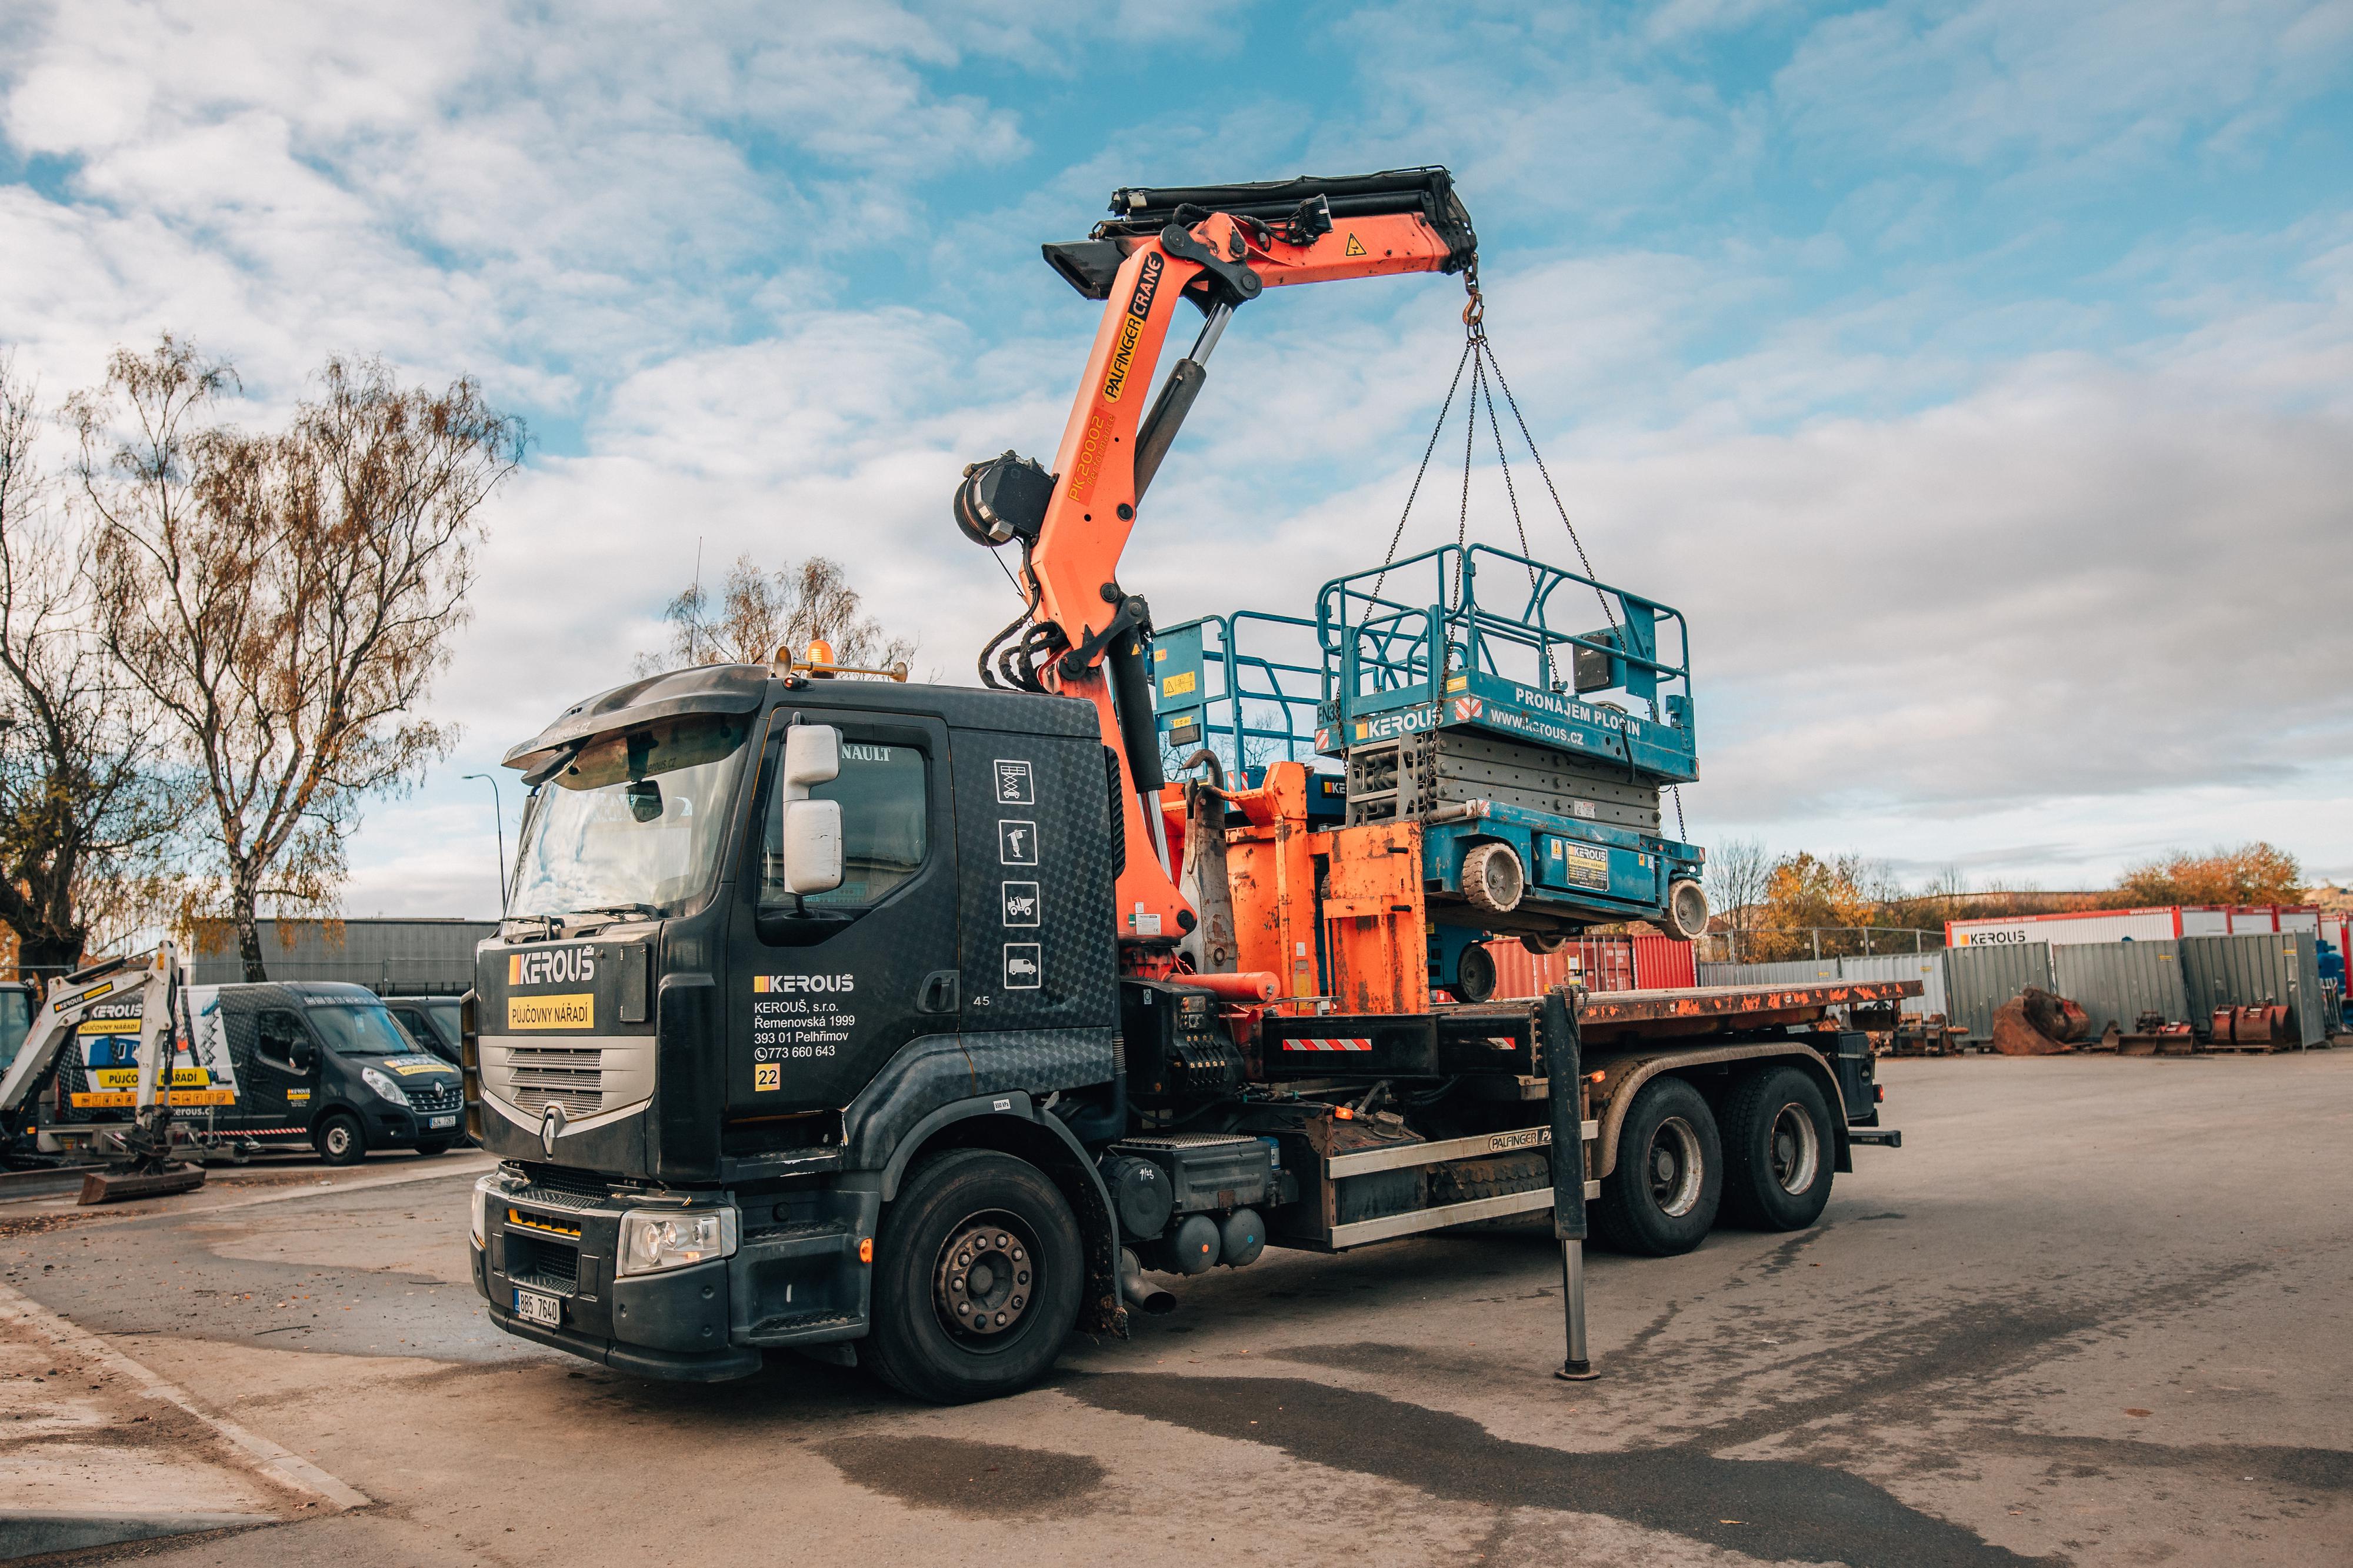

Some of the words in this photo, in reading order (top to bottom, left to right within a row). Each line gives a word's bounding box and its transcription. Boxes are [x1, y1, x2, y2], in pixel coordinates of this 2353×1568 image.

[1105, 318, 1141, 399] PALFINGER
[1133, 259, 1161, 315] CRANE
[1068, 476, 1085, 501] PK
[1077, 415, 1104, 476] 20002
[1086, 414, 1115, 486] Performance
[1516, 686, 1591, 722] PRONÁJEM
[1317, 703, 1338, 724] EN3
[841, 745, 891, 762] NAULT
[520, 945, 595, 985] KEROUŠ
[769, 973, 854, 993] KEROUŠ
[754, 999, 809, 1014] KEROUŠ,
[812, 1003, 839, 1012] s.r.o.
[973, 996, 990, 1006] 45
[512, 1005, 553, 1023] PŮJČOVNY
[555, 1002, 588, 1022] NÁŘADÍ
[755, 1015, 826, 1029] Řemenovská
[829, 1015, 855, 1026] 1999
[754, 1033, 775, 1044] 393
[778, 1032, 791, 1043] 01
[795, 1031, 849, 1043] Pelhřimov
[768, 1047, 789, 1059] 773
[792, 1046, 812, 1057] 660
[815, 1045, 835, 1057] 643
[109, 1072, 138, 1084] PŮJČO
[758, 1069, 778, 1085] 22
[1492, 1132, 1537, 1149] PALFINGER
[521, 1293, 533, 1315] 8B5
[538, 1297, 557, 1321] 7640
